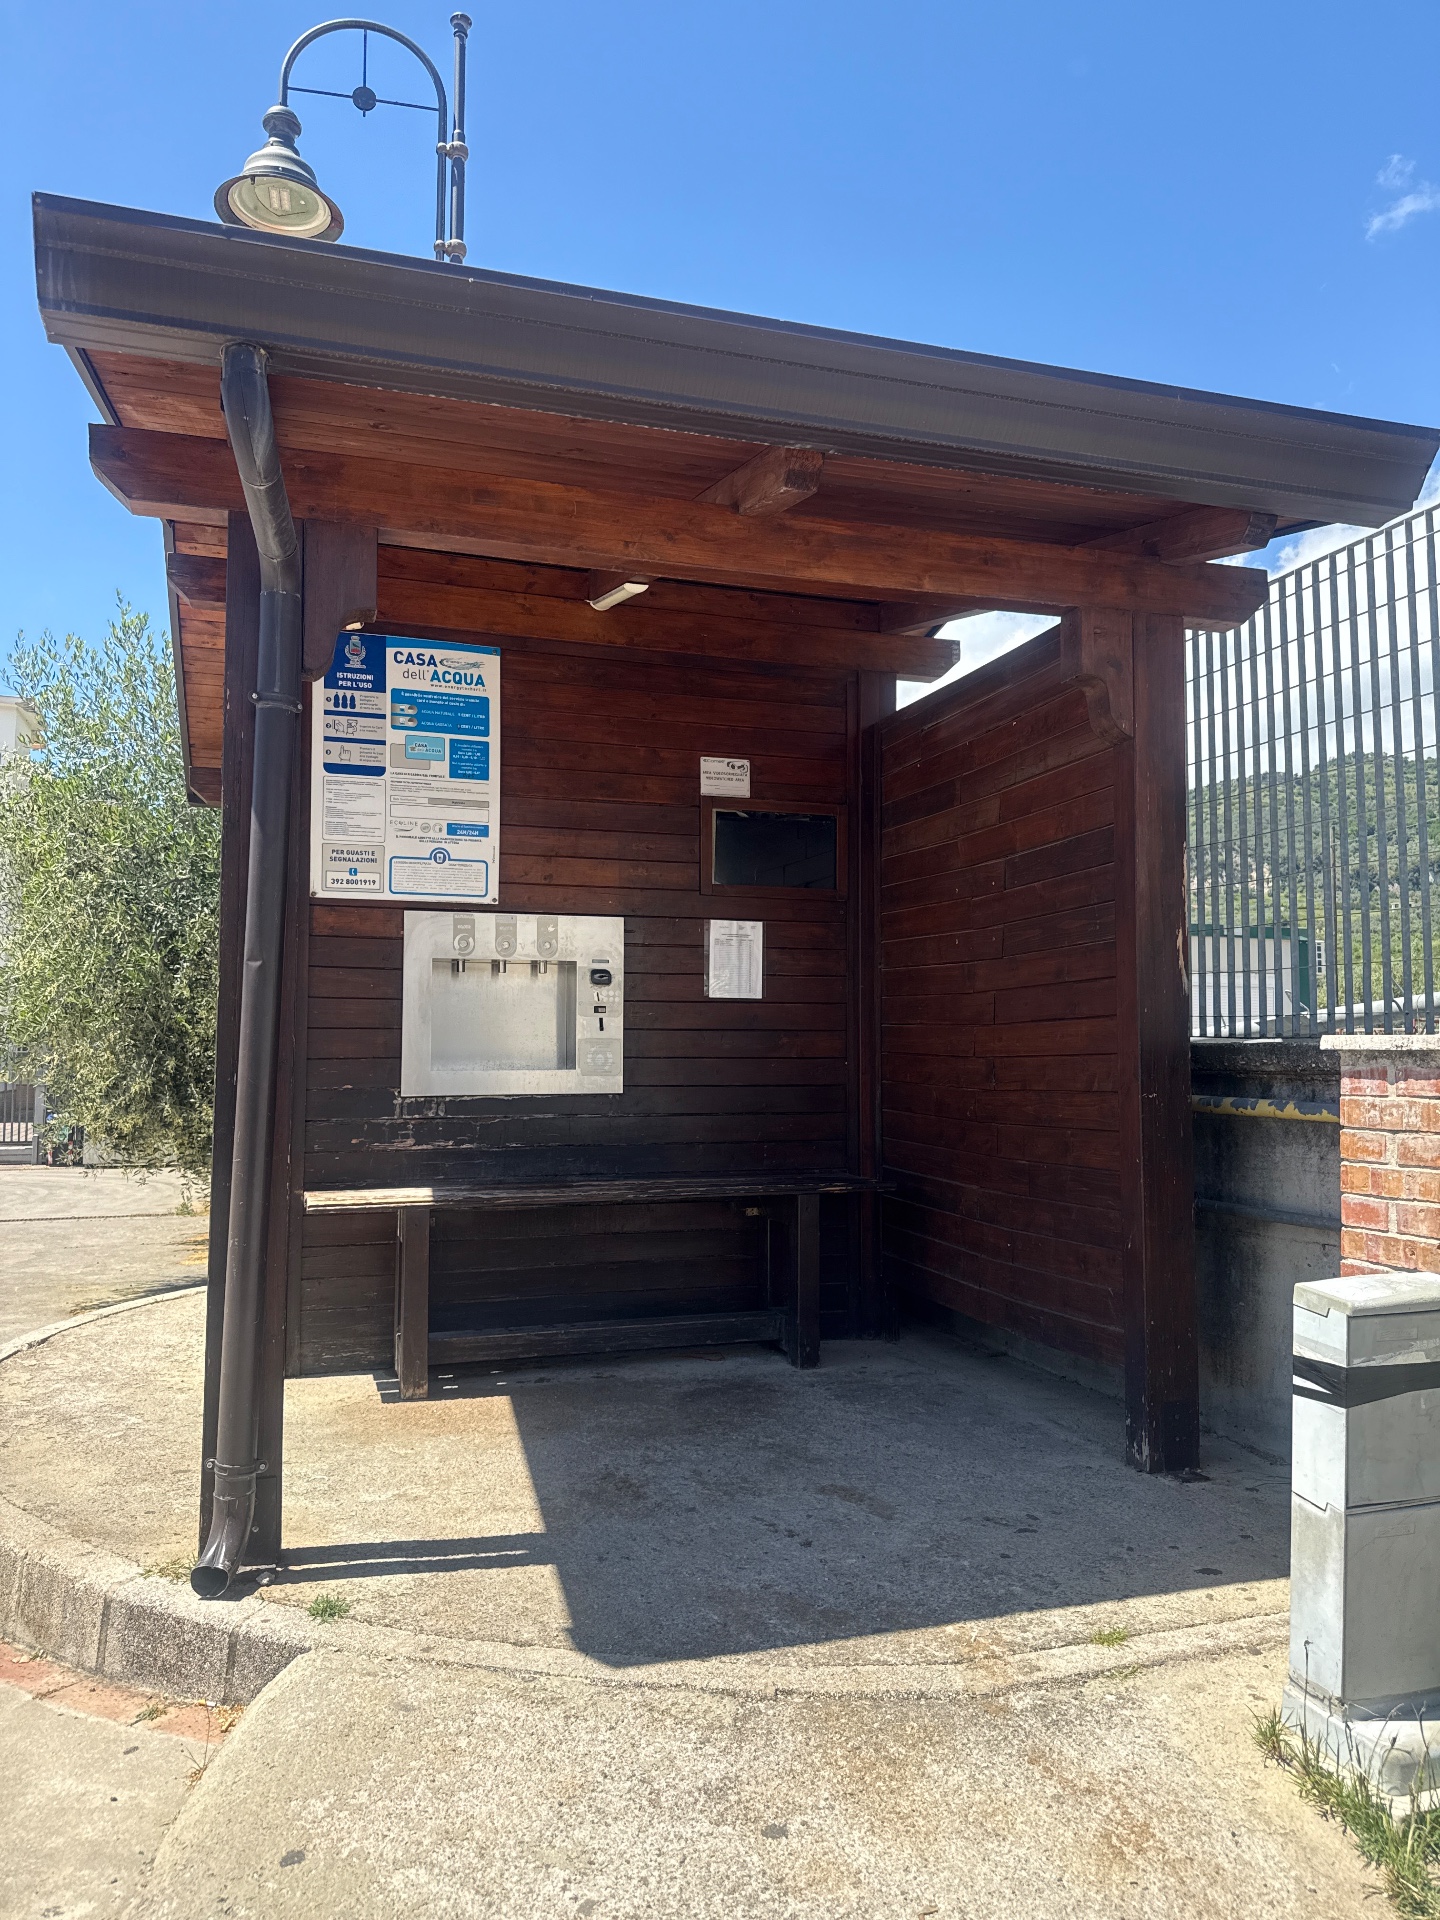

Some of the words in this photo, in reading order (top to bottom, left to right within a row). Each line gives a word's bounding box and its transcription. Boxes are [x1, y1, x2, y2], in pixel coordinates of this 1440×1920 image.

[393, 650, 438, 668] CASA
[336, 671, 374, 681] ISTRUZIONI
[338, 680, 352, 688] PER
[353, 681, 373, 689] L'USO
[329, 856, 378, 864] SEGNALAZIONI
[345, 878, 377, 886] 8001919
